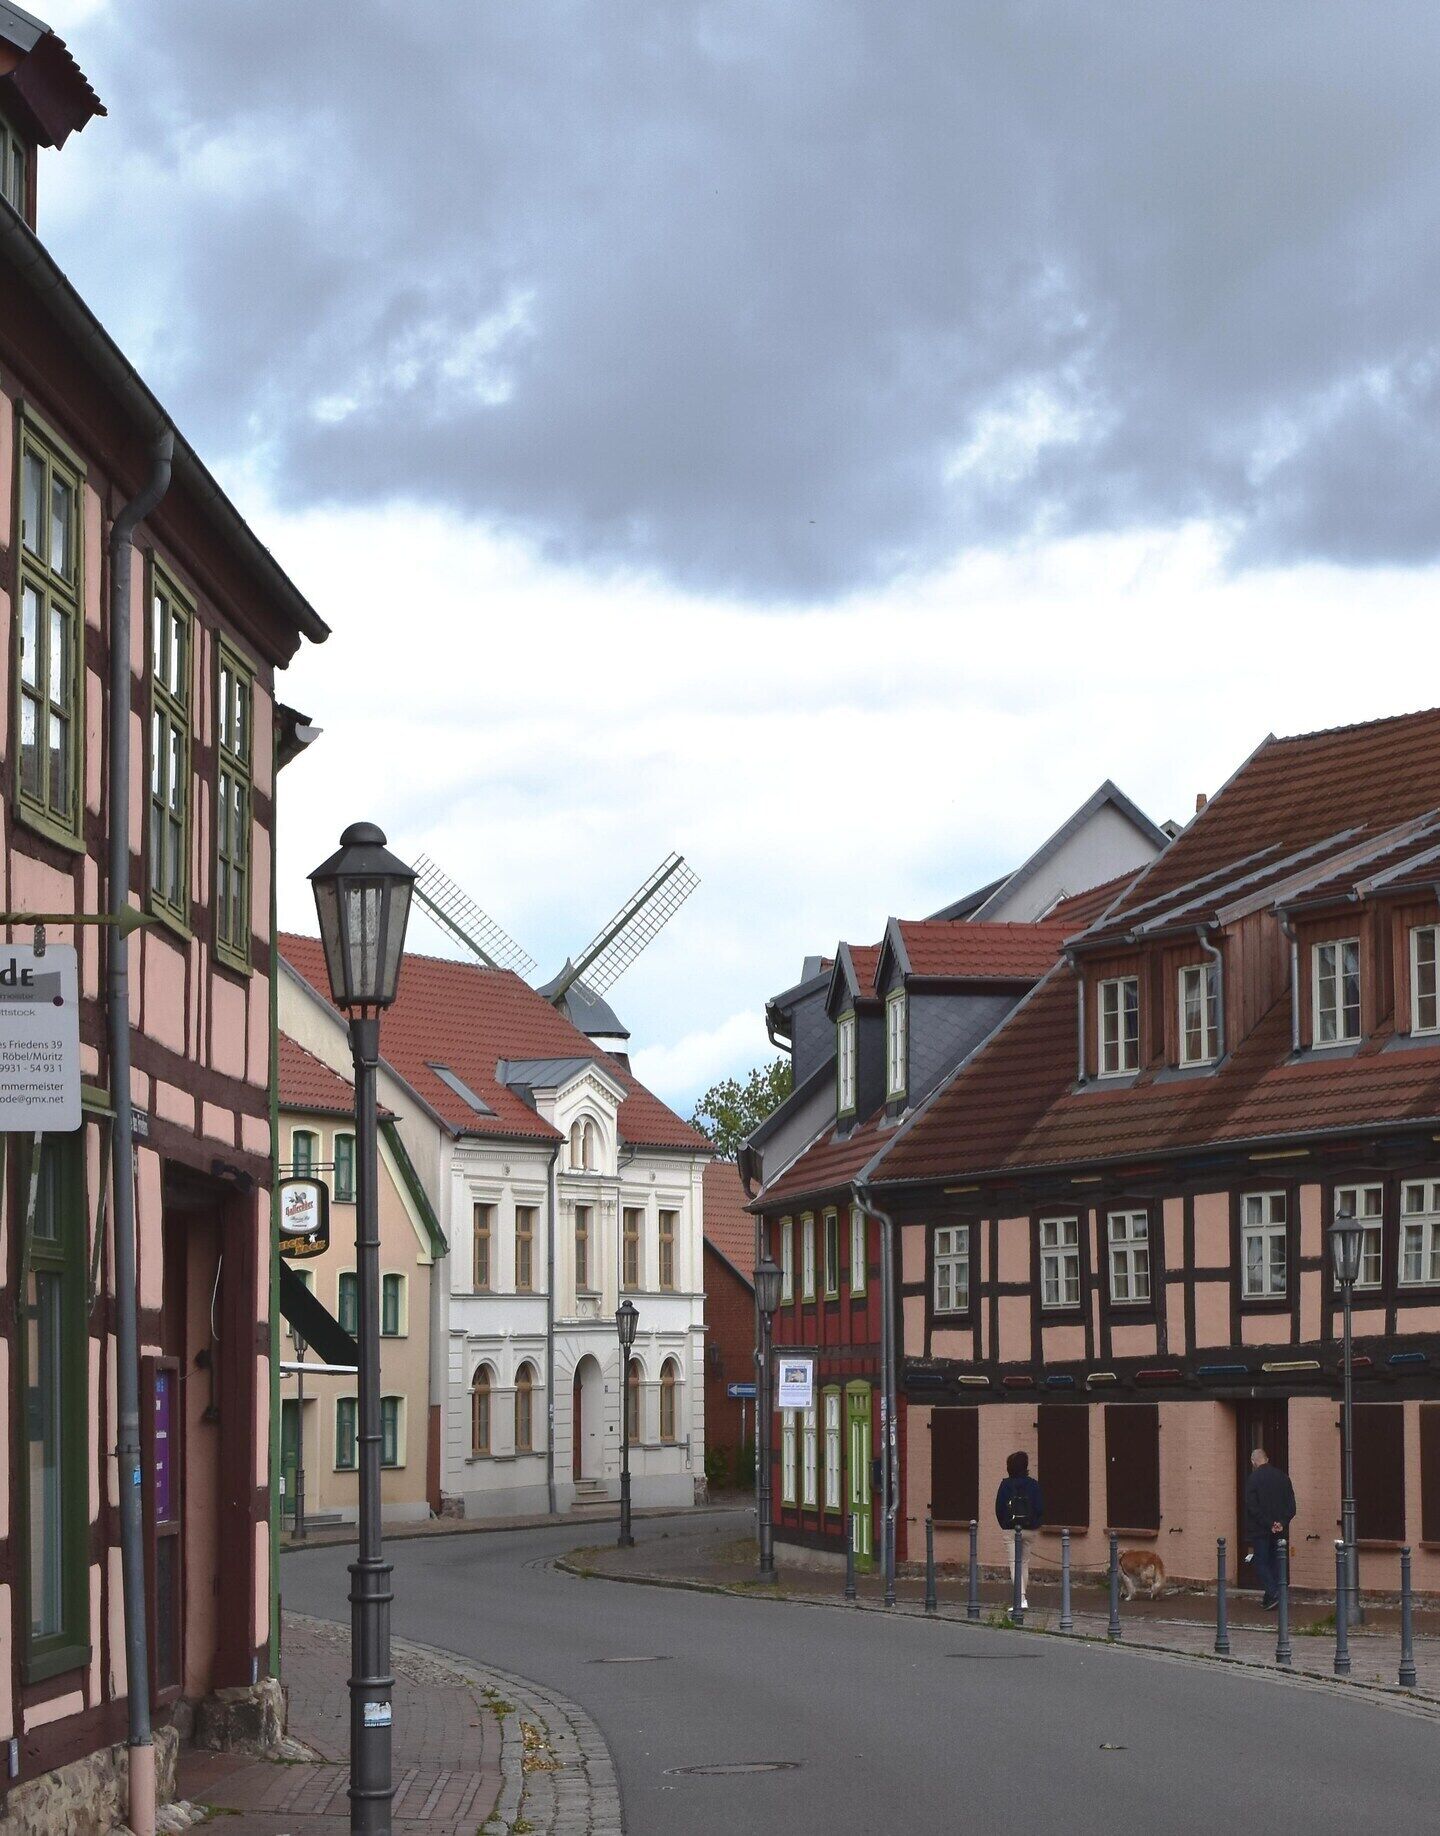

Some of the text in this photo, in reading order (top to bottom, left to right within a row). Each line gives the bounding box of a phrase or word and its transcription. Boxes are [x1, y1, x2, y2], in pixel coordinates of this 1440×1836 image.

[0, 1008, 35, 1017] ttstock
[9, 1040, 48, 1049] Friedens
[51, 1040, 63, 1049] 39
[2, 1052, 63, 1061] Röbel/Müritz
[30, 1064, 41, 1073] 54
[43, 1064, 54, 1073] 93
[58, 1064, 62, 1072] 1
